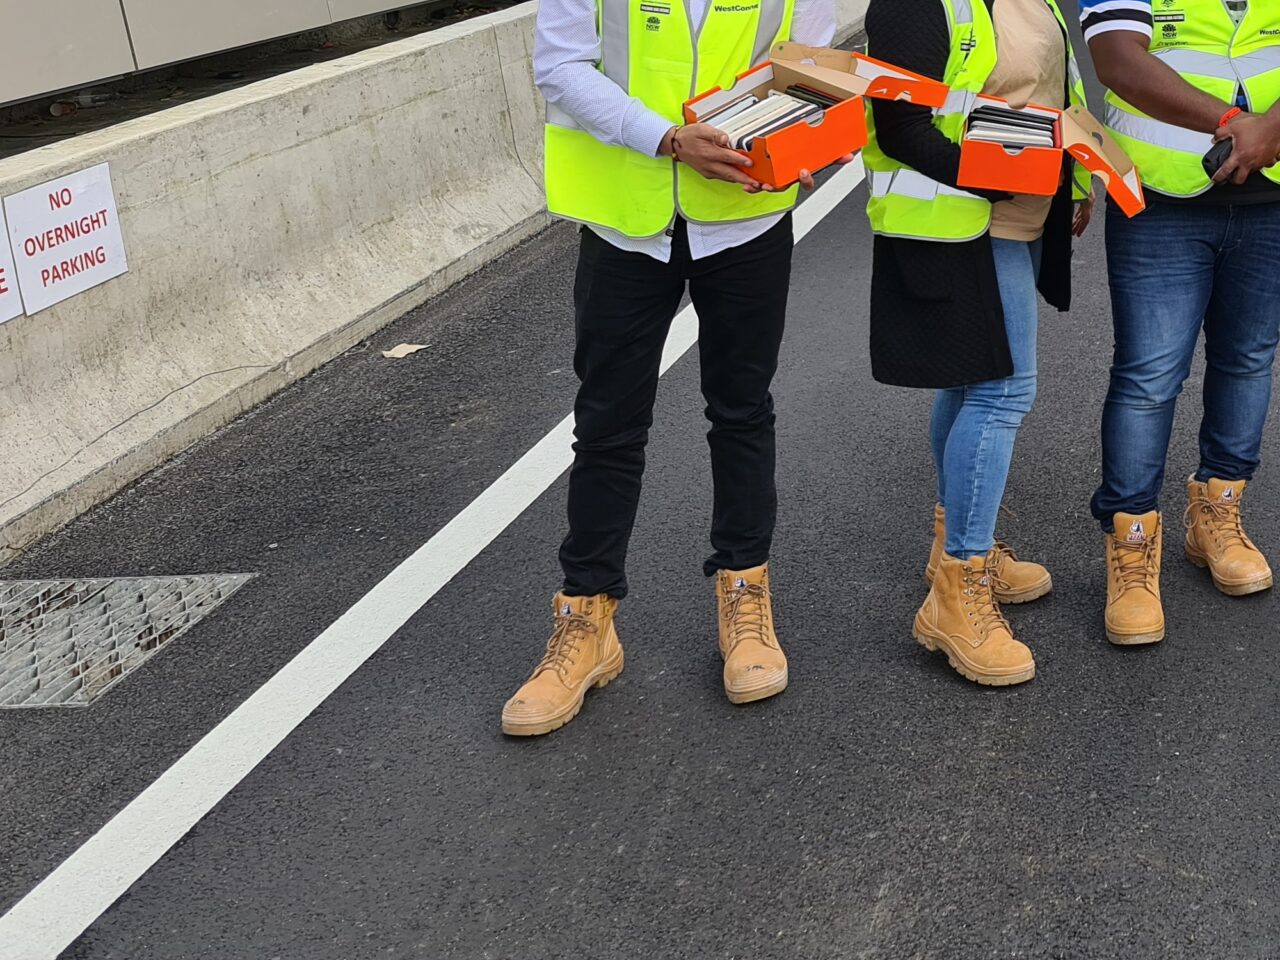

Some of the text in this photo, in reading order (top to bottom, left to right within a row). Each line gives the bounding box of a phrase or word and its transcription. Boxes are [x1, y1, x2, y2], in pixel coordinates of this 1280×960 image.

[48, 187, 72, 211] NO
[24, 209, 108, 257] OVERNIGHT
[41, 246, 106, 288] PARKING
